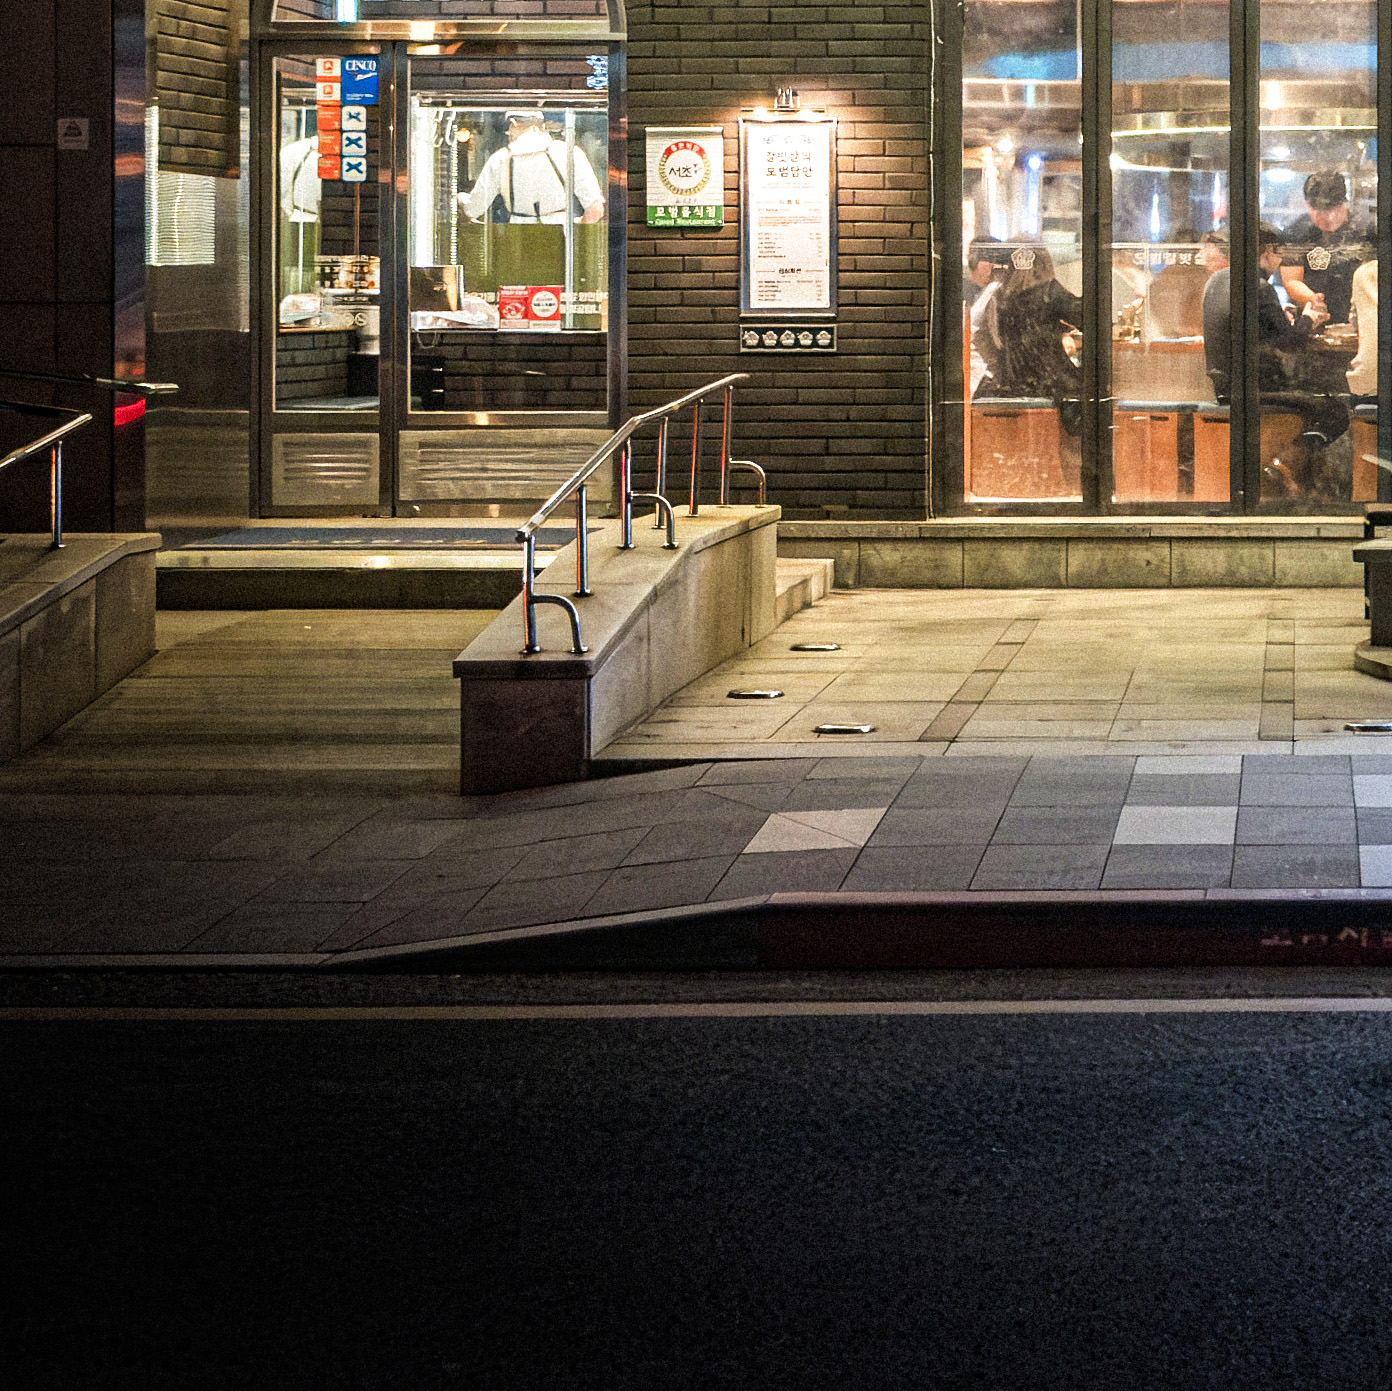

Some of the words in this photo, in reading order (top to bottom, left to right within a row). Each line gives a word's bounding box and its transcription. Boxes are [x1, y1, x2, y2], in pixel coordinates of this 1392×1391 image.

[669, 165, 692, 177] 서초
[765, 165, 813, 178] 모범답안
[654, 205, 716, 218] 모범음식점
